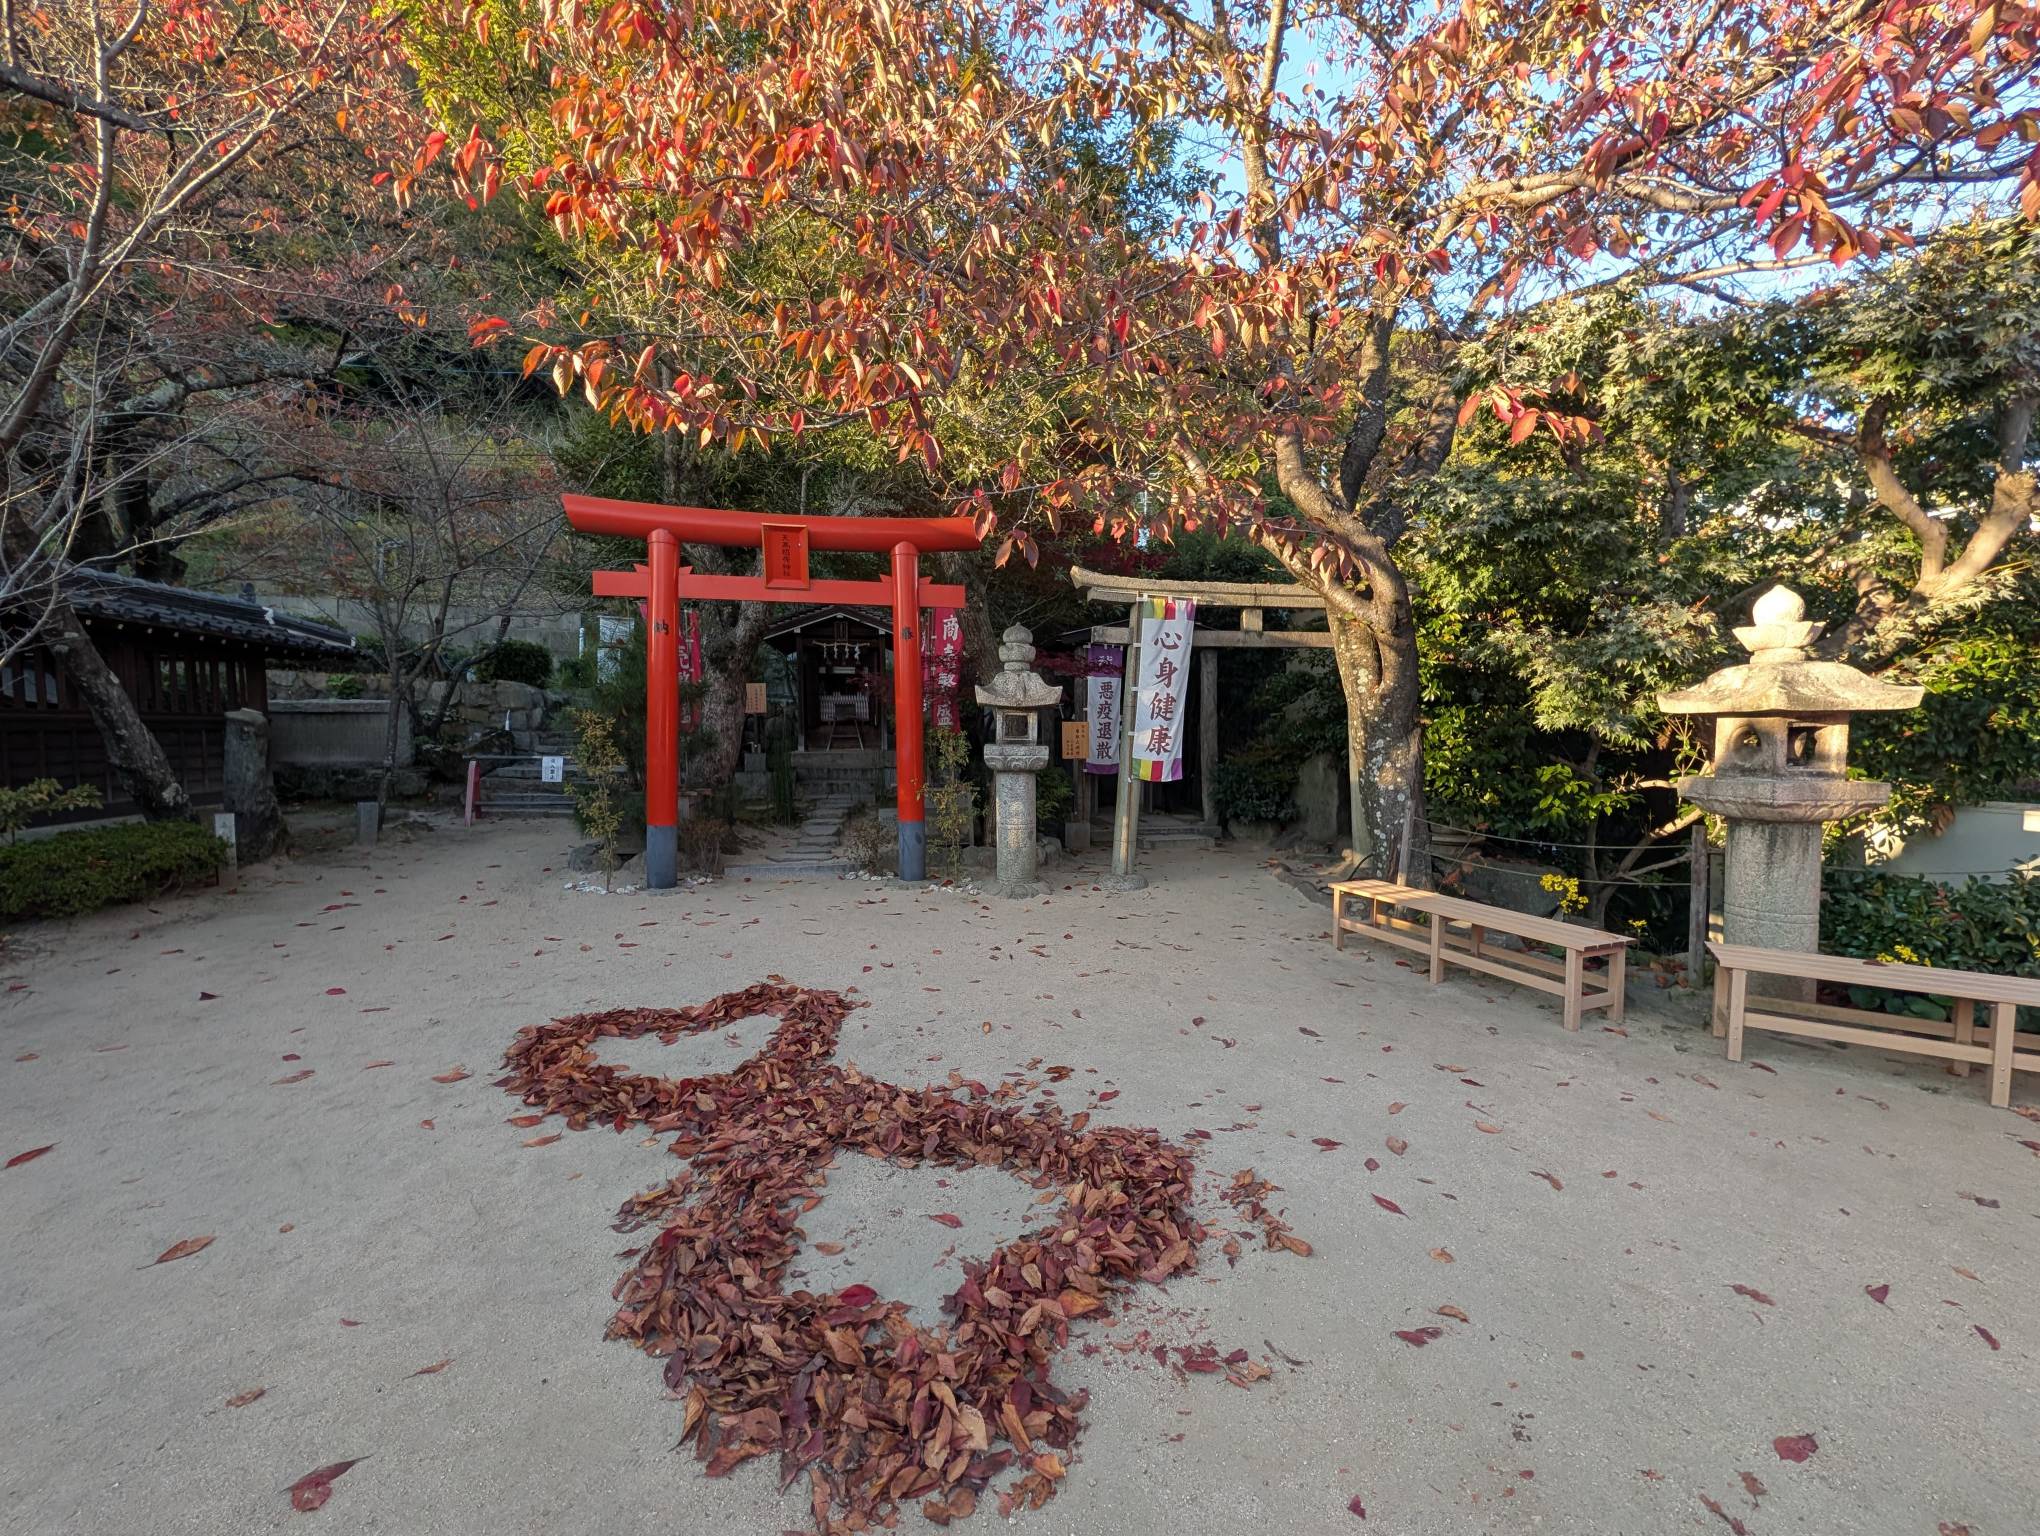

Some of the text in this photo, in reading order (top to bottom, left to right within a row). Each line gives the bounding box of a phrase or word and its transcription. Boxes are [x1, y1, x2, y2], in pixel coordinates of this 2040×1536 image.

[1096, 681, 1114, 761] 悪疫退散
[1145, 631, 1183, 757] 心身健康
